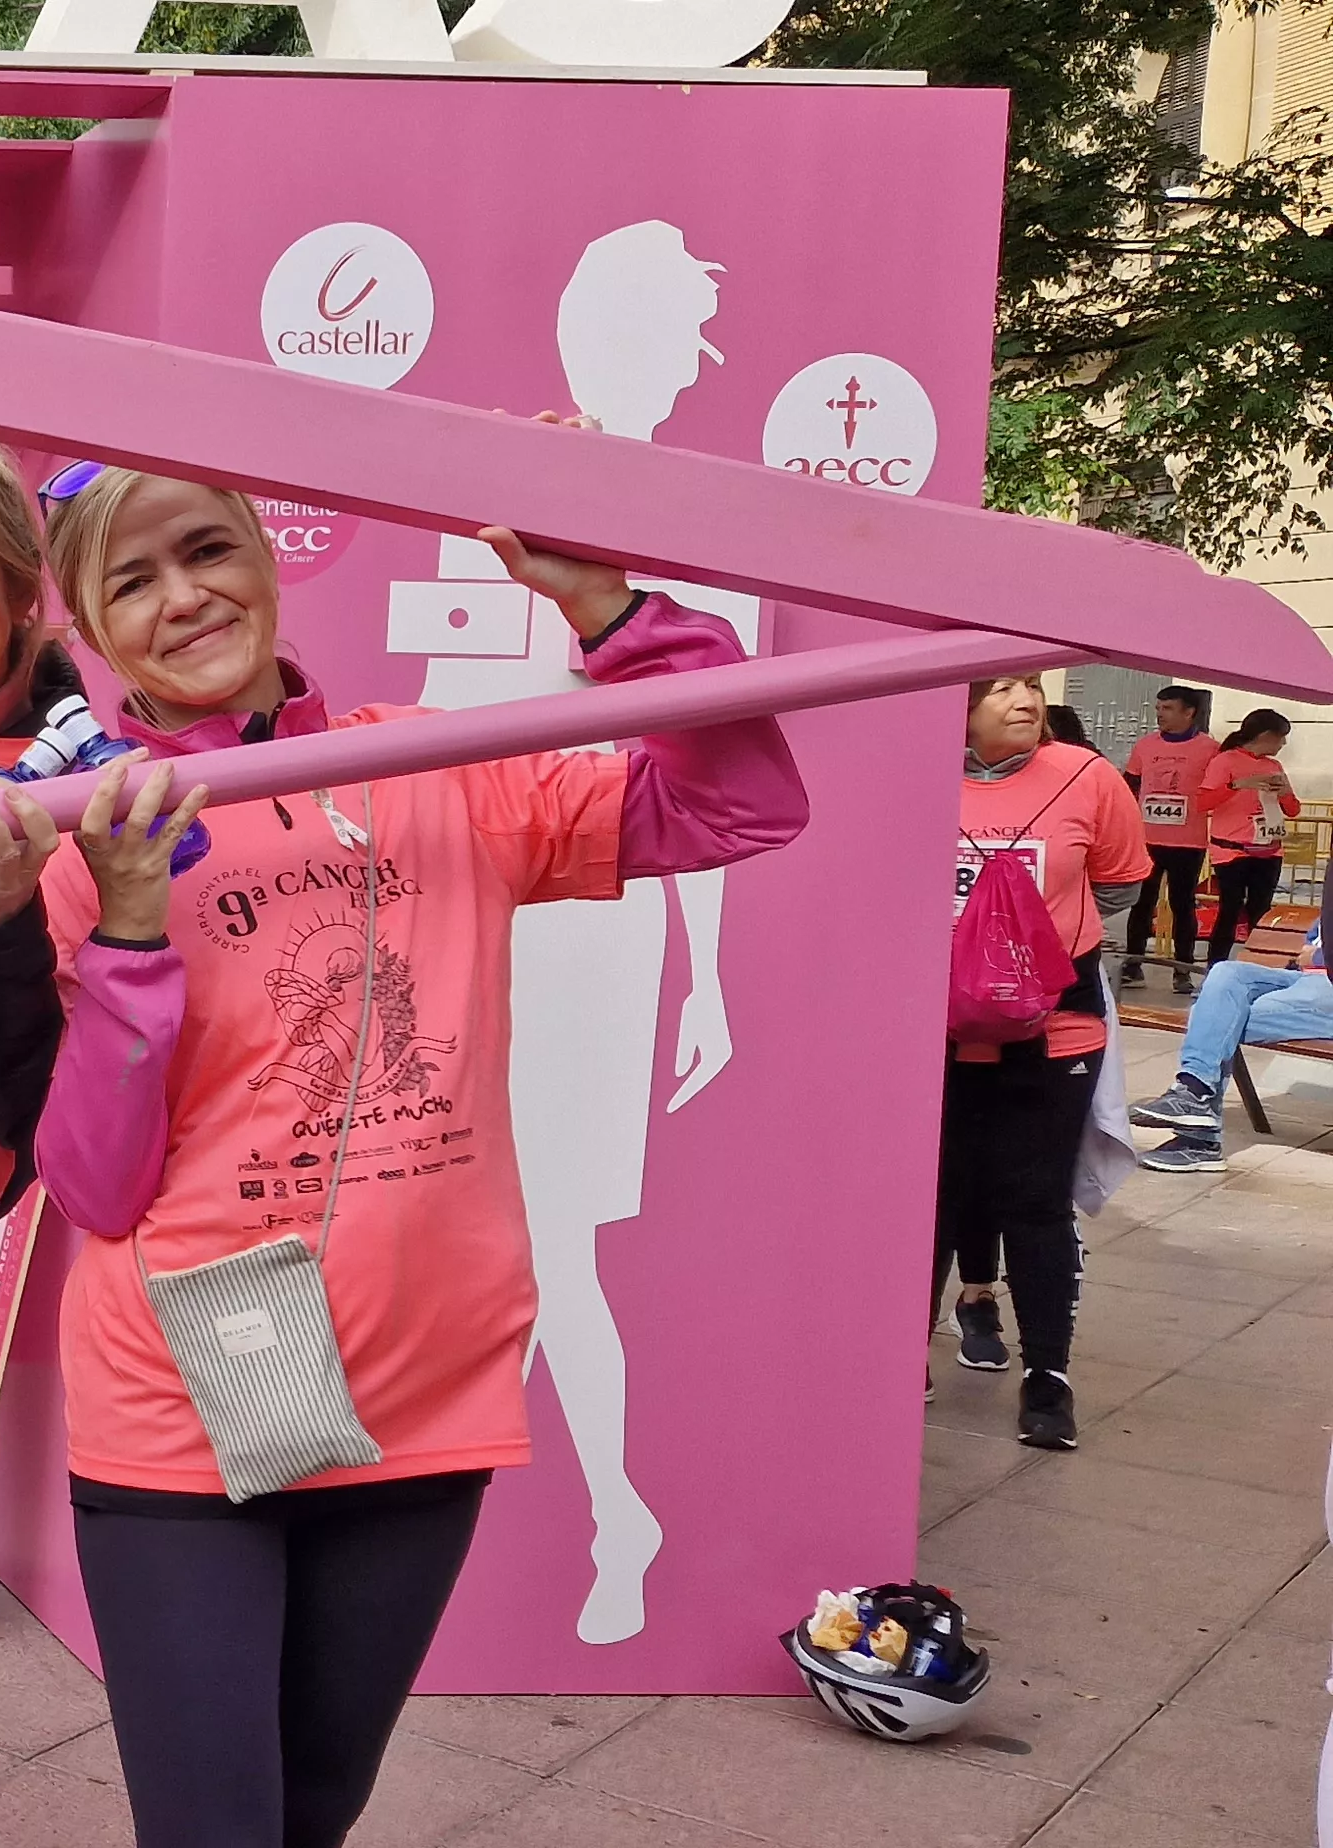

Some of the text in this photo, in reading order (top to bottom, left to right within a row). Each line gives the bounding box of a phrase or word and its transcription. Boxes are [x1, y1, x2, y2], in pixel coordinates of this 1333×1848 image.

[277, 319, 414, 355] castellar
[1145, 804, 1182, 817] 1444
[245, 867, 261, 879] EL
[394, 1095, 453, 1121] MUCHO
